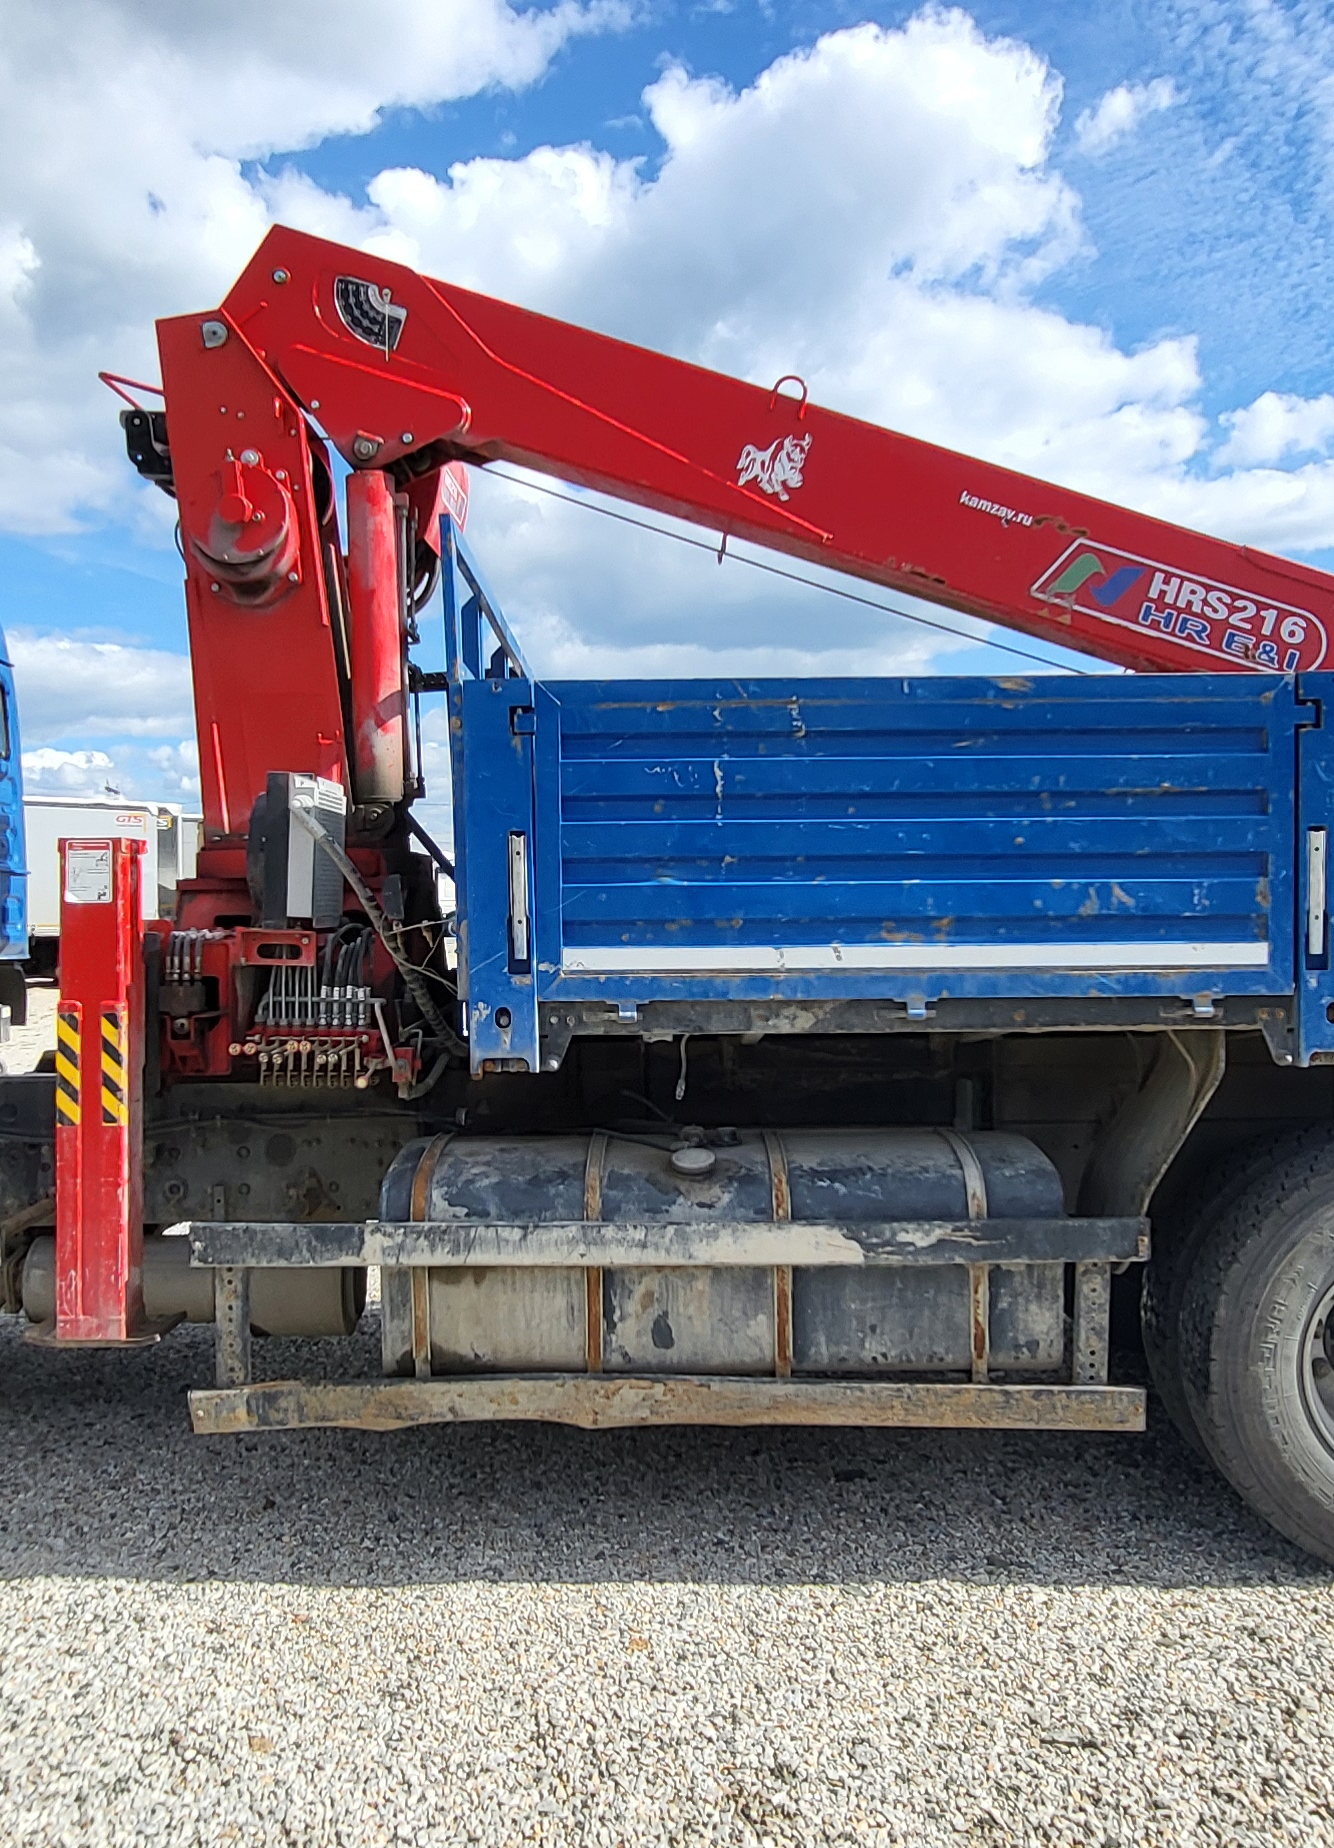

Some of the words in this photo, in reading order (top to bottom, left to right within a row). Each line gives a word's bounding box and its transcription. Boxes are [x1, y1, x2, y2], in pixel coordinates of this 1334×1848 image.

[1138, 601, 1211, 646] HR
[1147, 571, 1308, 645] HRS216
[116, 815, 143, 824] GTS
